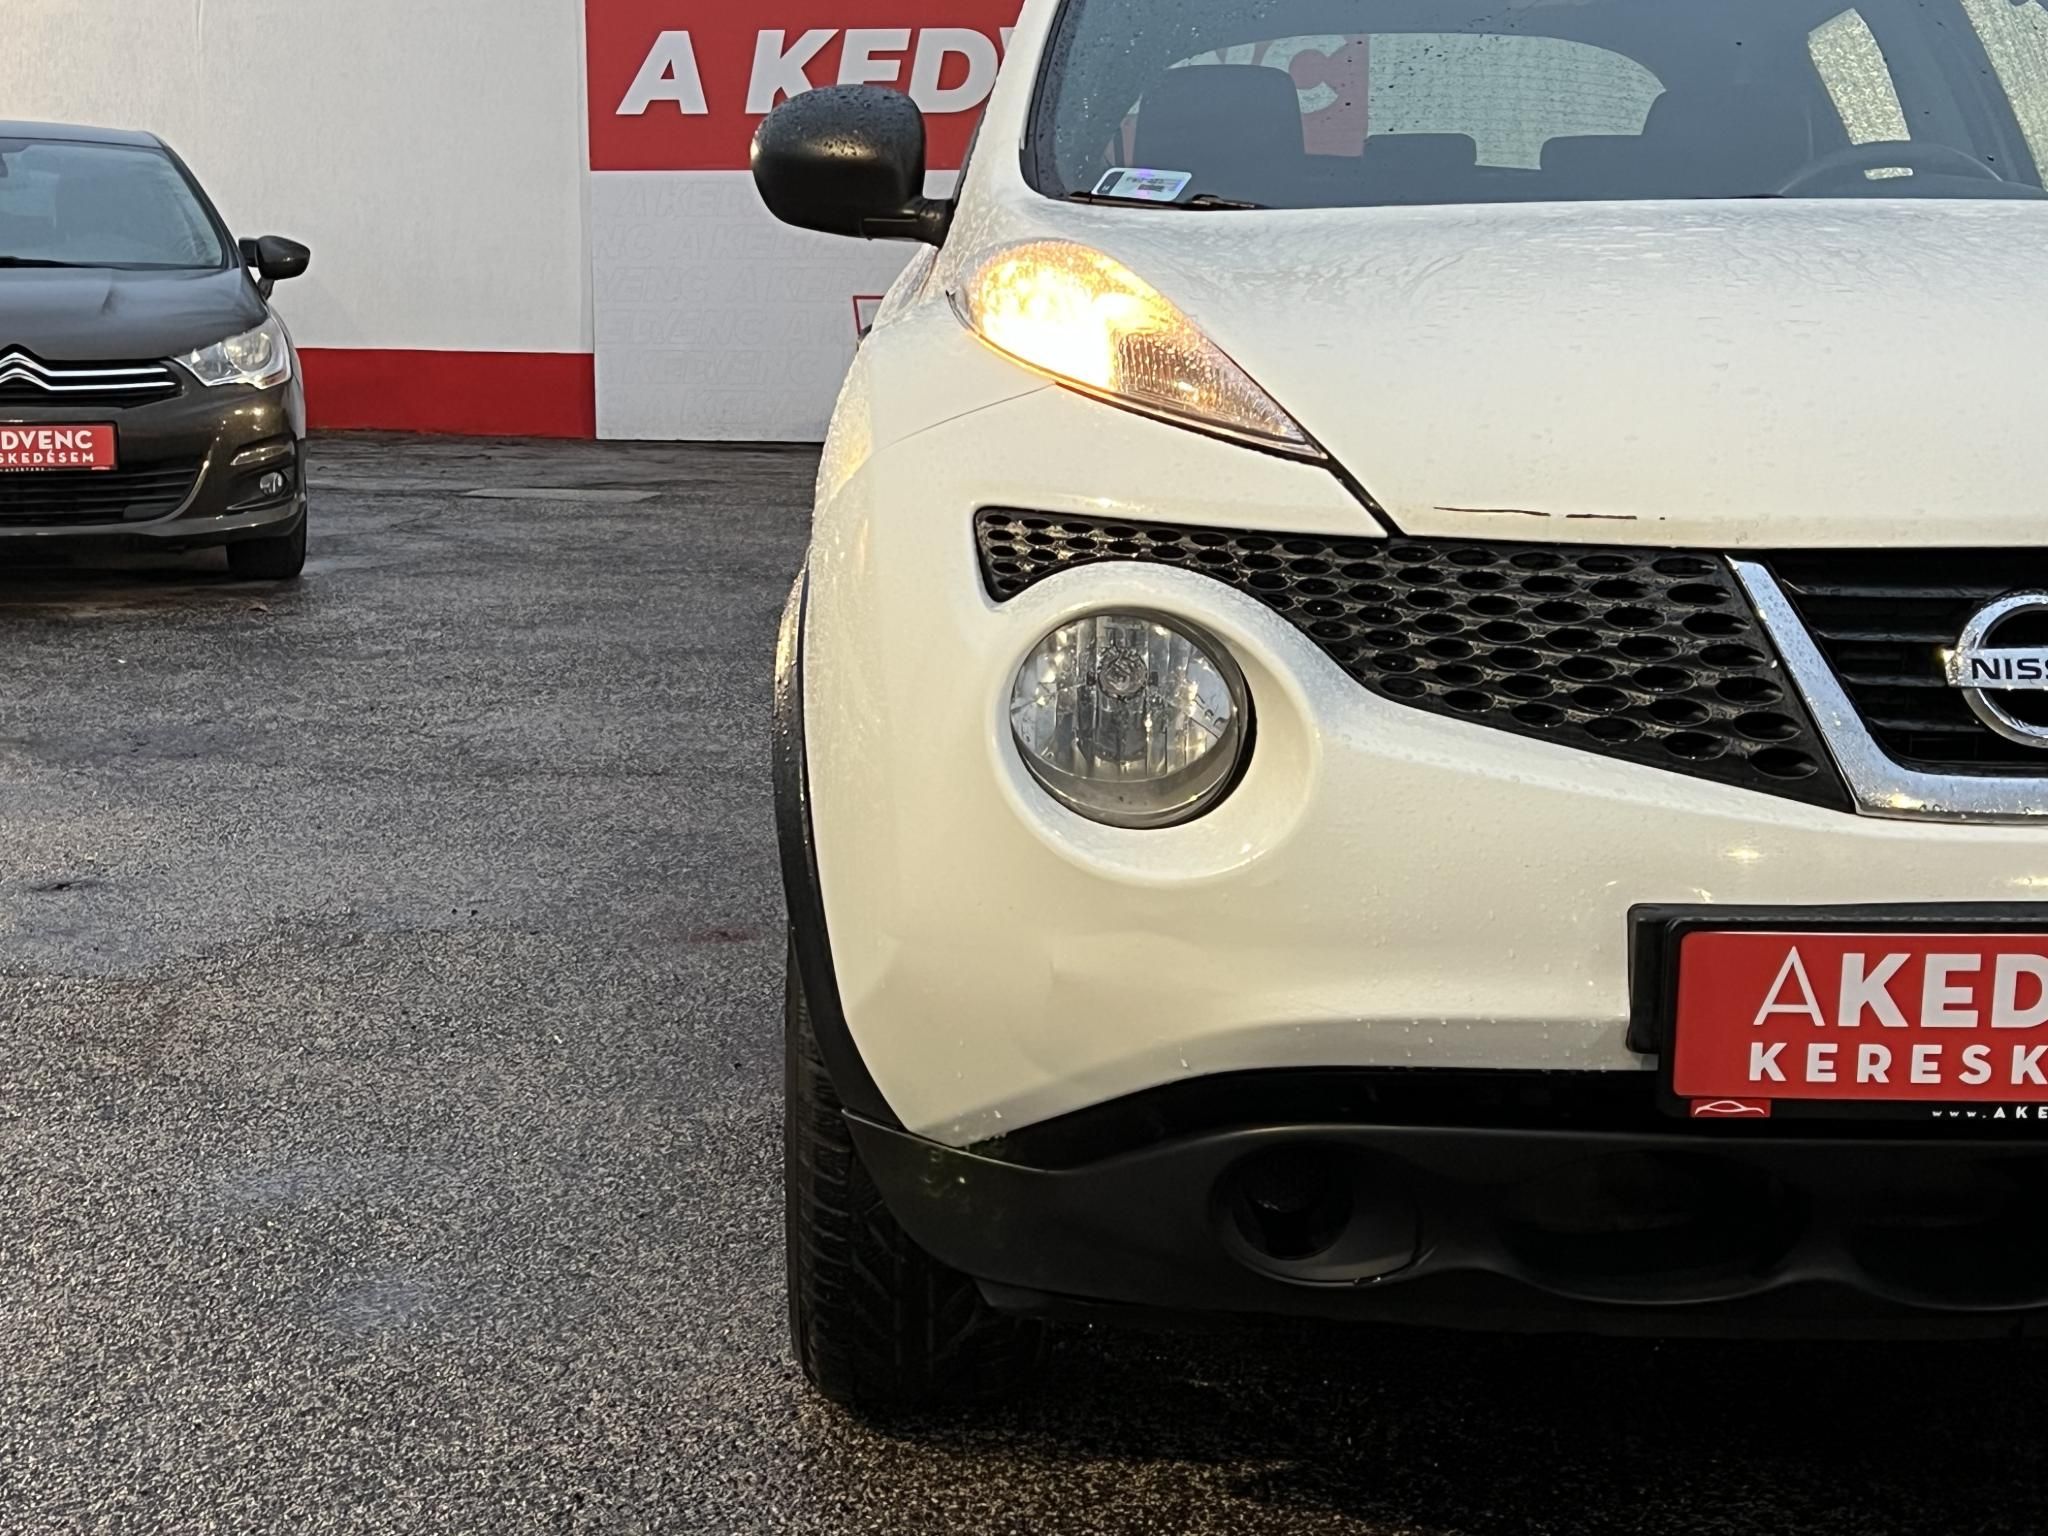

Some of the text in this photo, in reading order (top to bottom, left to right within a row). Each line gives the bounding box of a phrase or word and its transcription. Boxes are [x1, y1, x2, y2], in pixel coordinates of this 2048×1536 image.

[616, 27, 1015, 115] A KED
[1, 430, 93, 450] DVENC
[1971, 658, 2048, 680] NIS
[1749, 1042, 2048, 1085] KERESK
